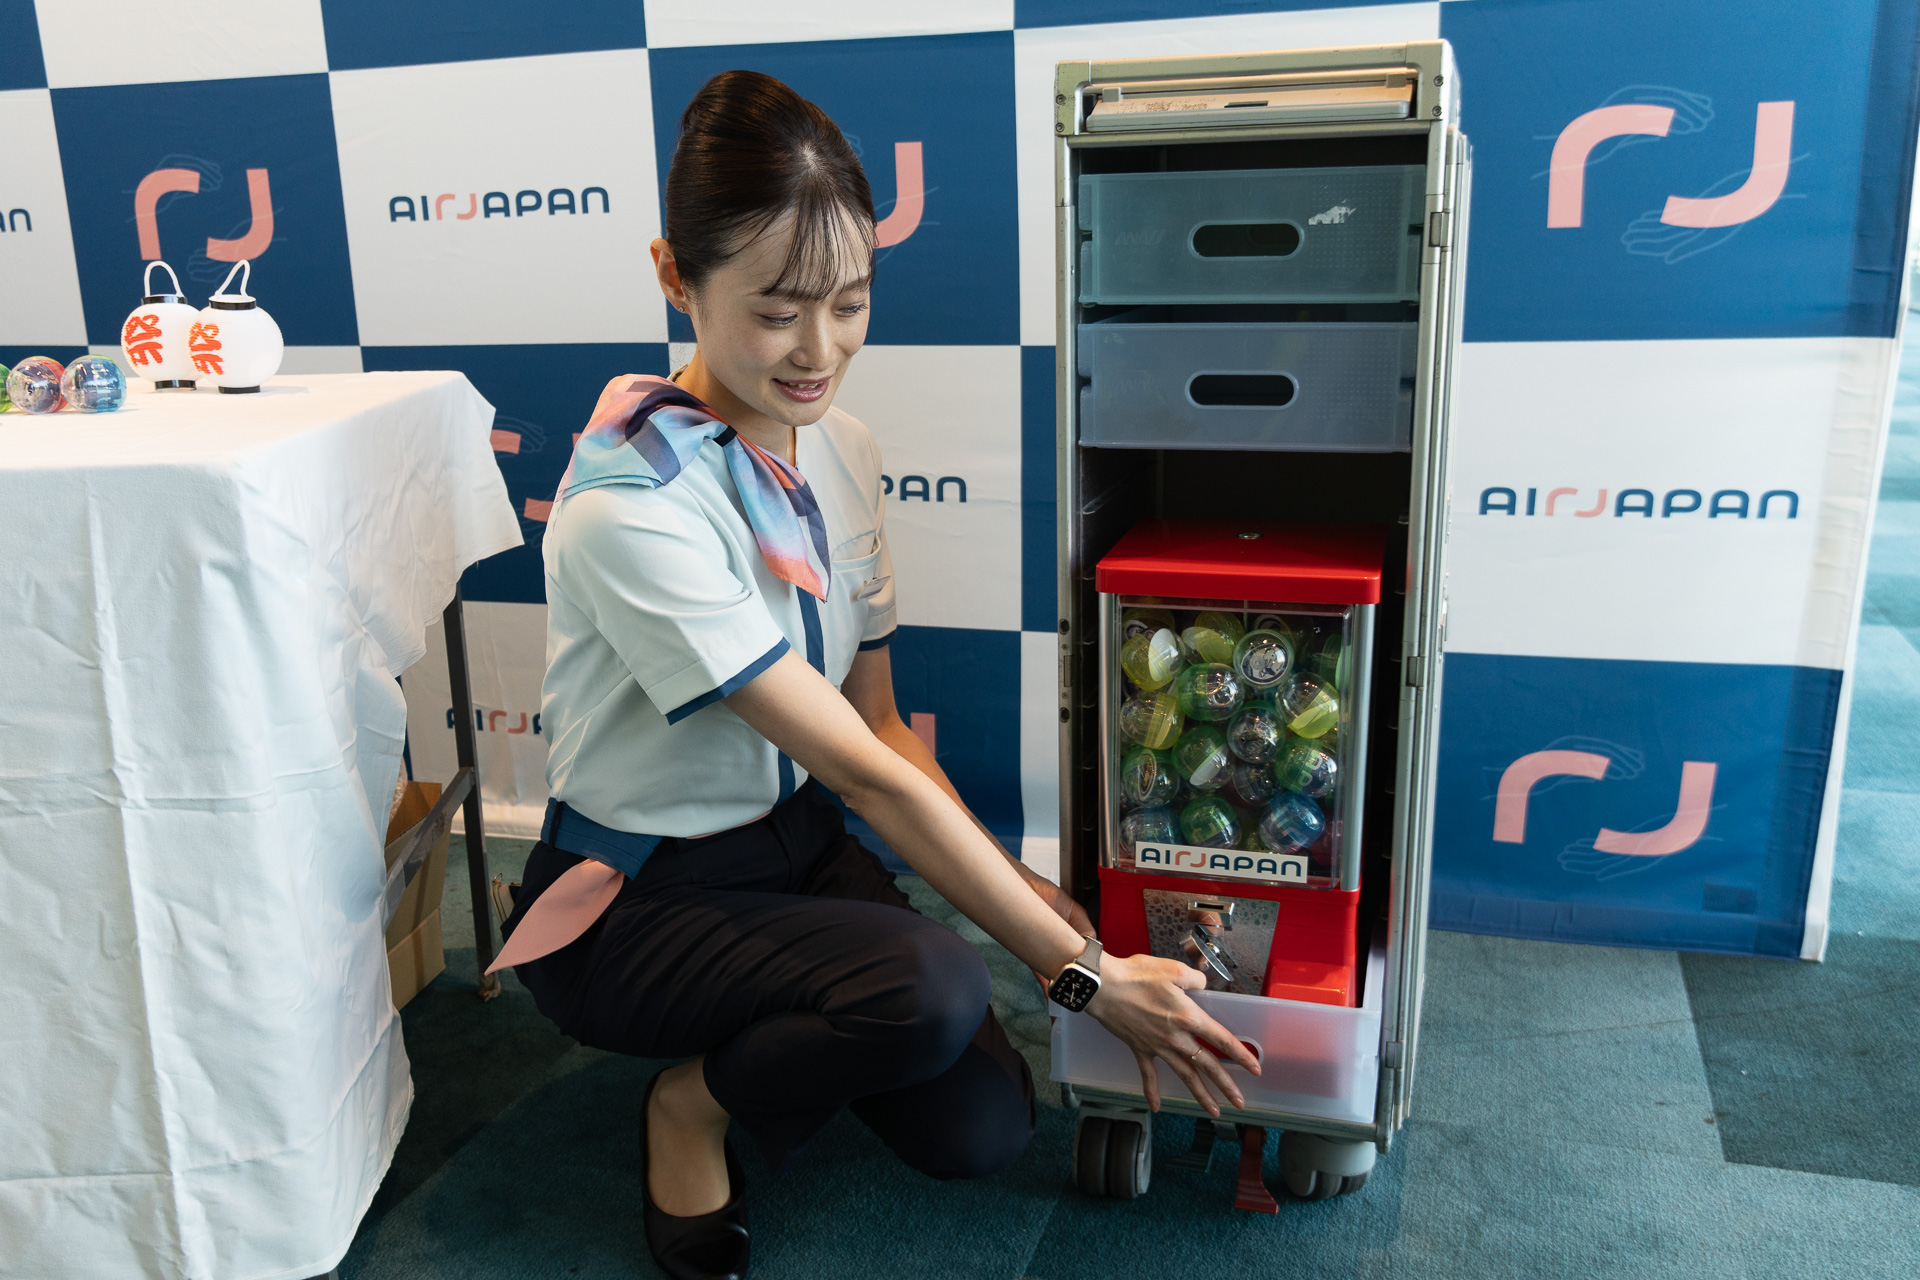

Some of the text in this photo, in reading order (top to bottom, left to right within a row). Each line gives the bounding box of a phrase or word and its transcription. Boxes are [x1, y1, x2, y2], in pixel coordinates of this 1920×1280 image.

[389, 186, 611, 222] AIRJAPAN
[1478, 487, 1800, 519] AIRJAPAN
[1141, 847, 1302, 877] AIRJAPAN
